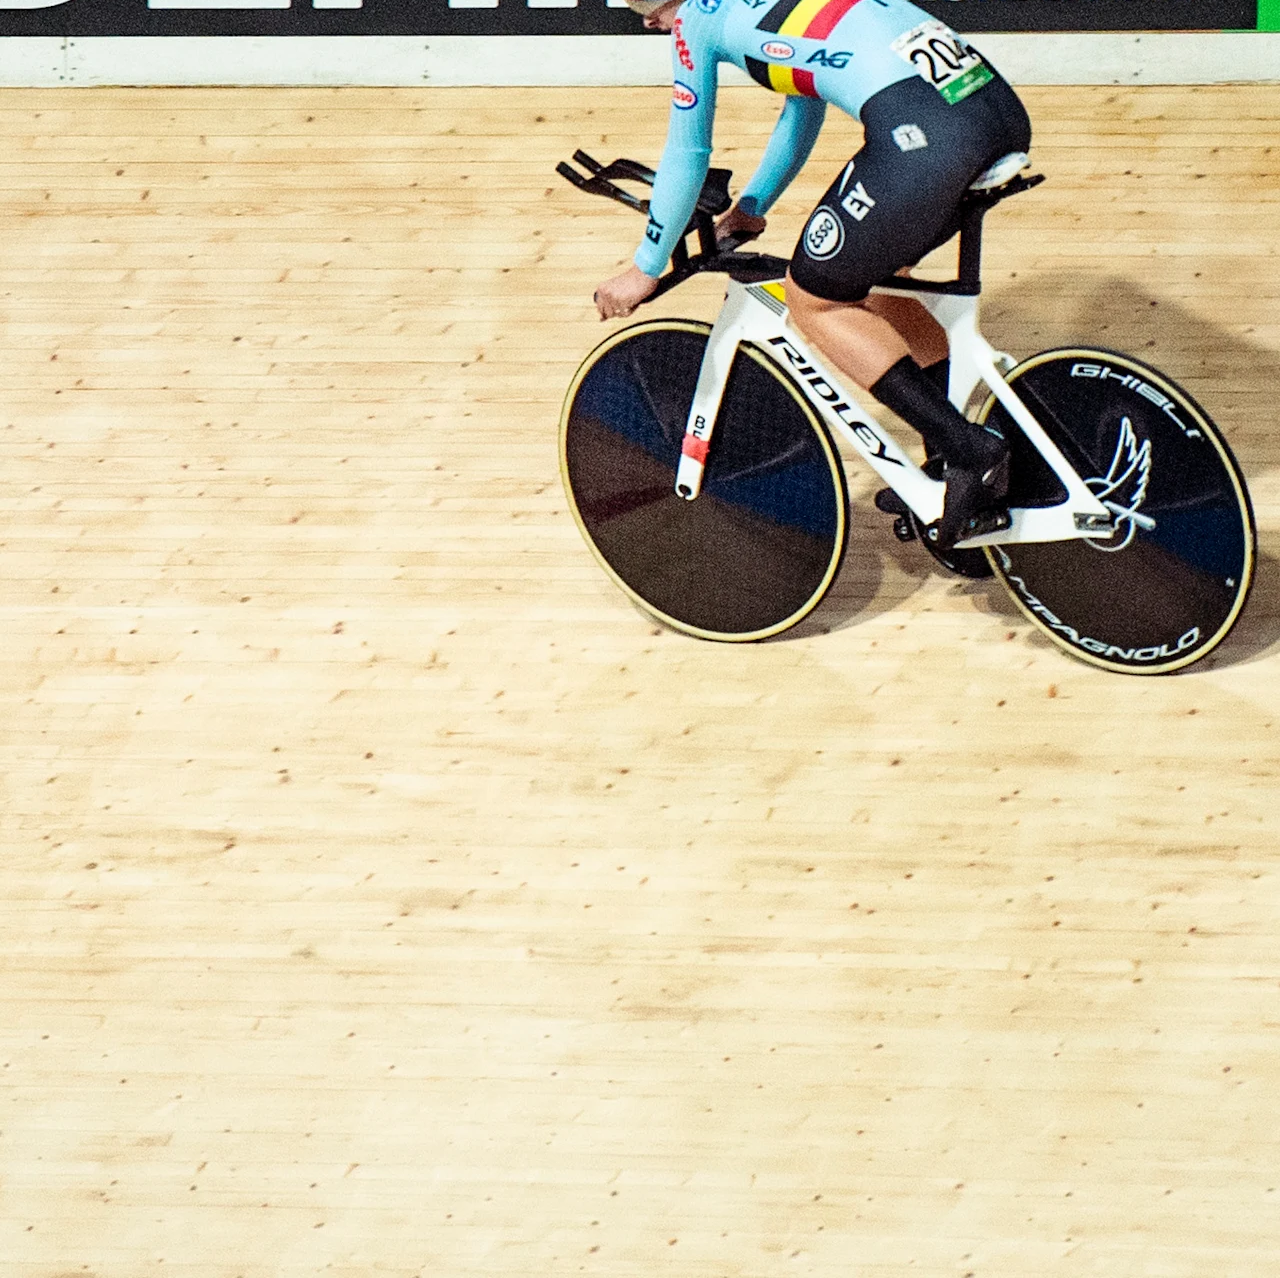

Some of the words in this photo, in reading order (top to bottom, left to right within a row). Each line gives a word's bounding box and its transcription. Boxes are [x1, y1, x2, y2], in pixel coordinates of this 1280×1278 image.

[806, 49, 854, 70] AG
[841, 181, 876, 221] EY
[767, 335, 907, 468] RIDLEY
